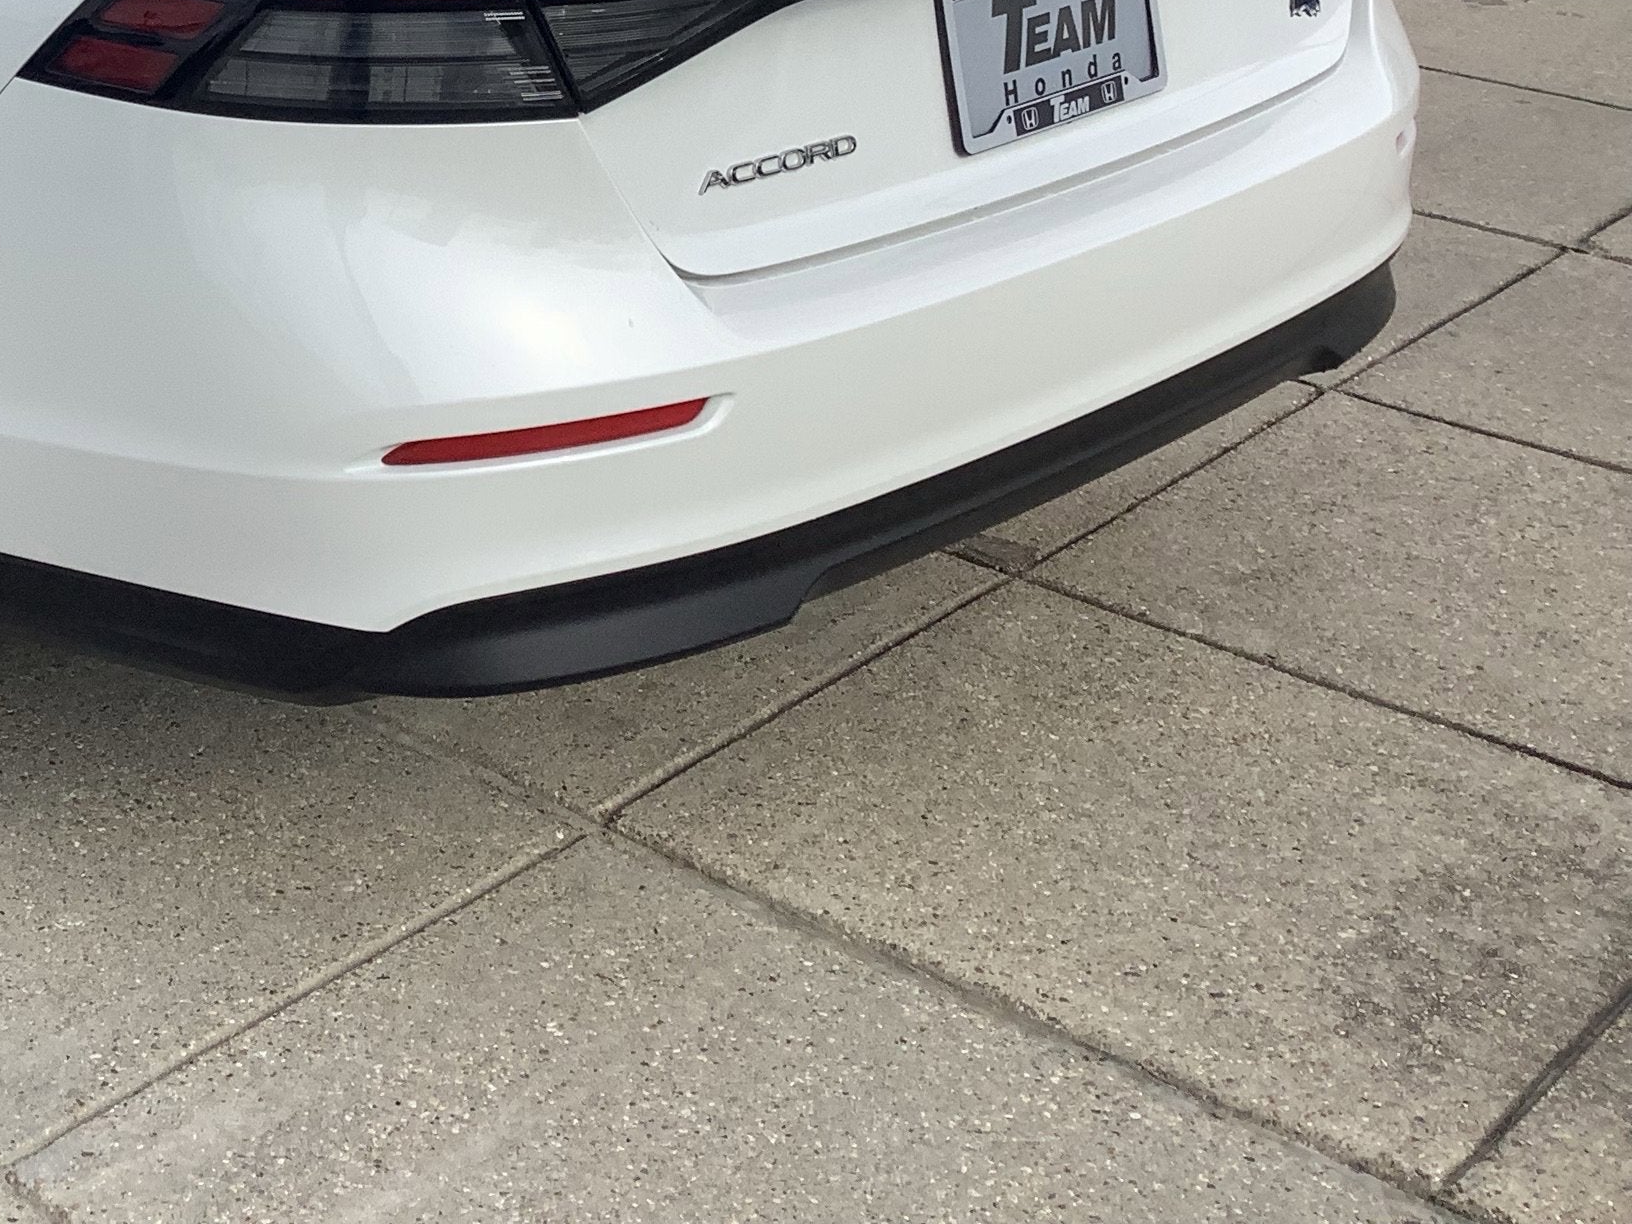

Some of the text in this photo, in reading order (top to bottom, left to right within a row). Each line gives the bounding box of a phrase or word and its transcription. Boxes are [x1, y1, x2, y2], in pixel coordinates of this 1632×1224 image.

[1003, 52, 1123, 107] Honda
[1050, 95, 1090, 124] TEAM
[698, 134, 858, 196] ACCORD
